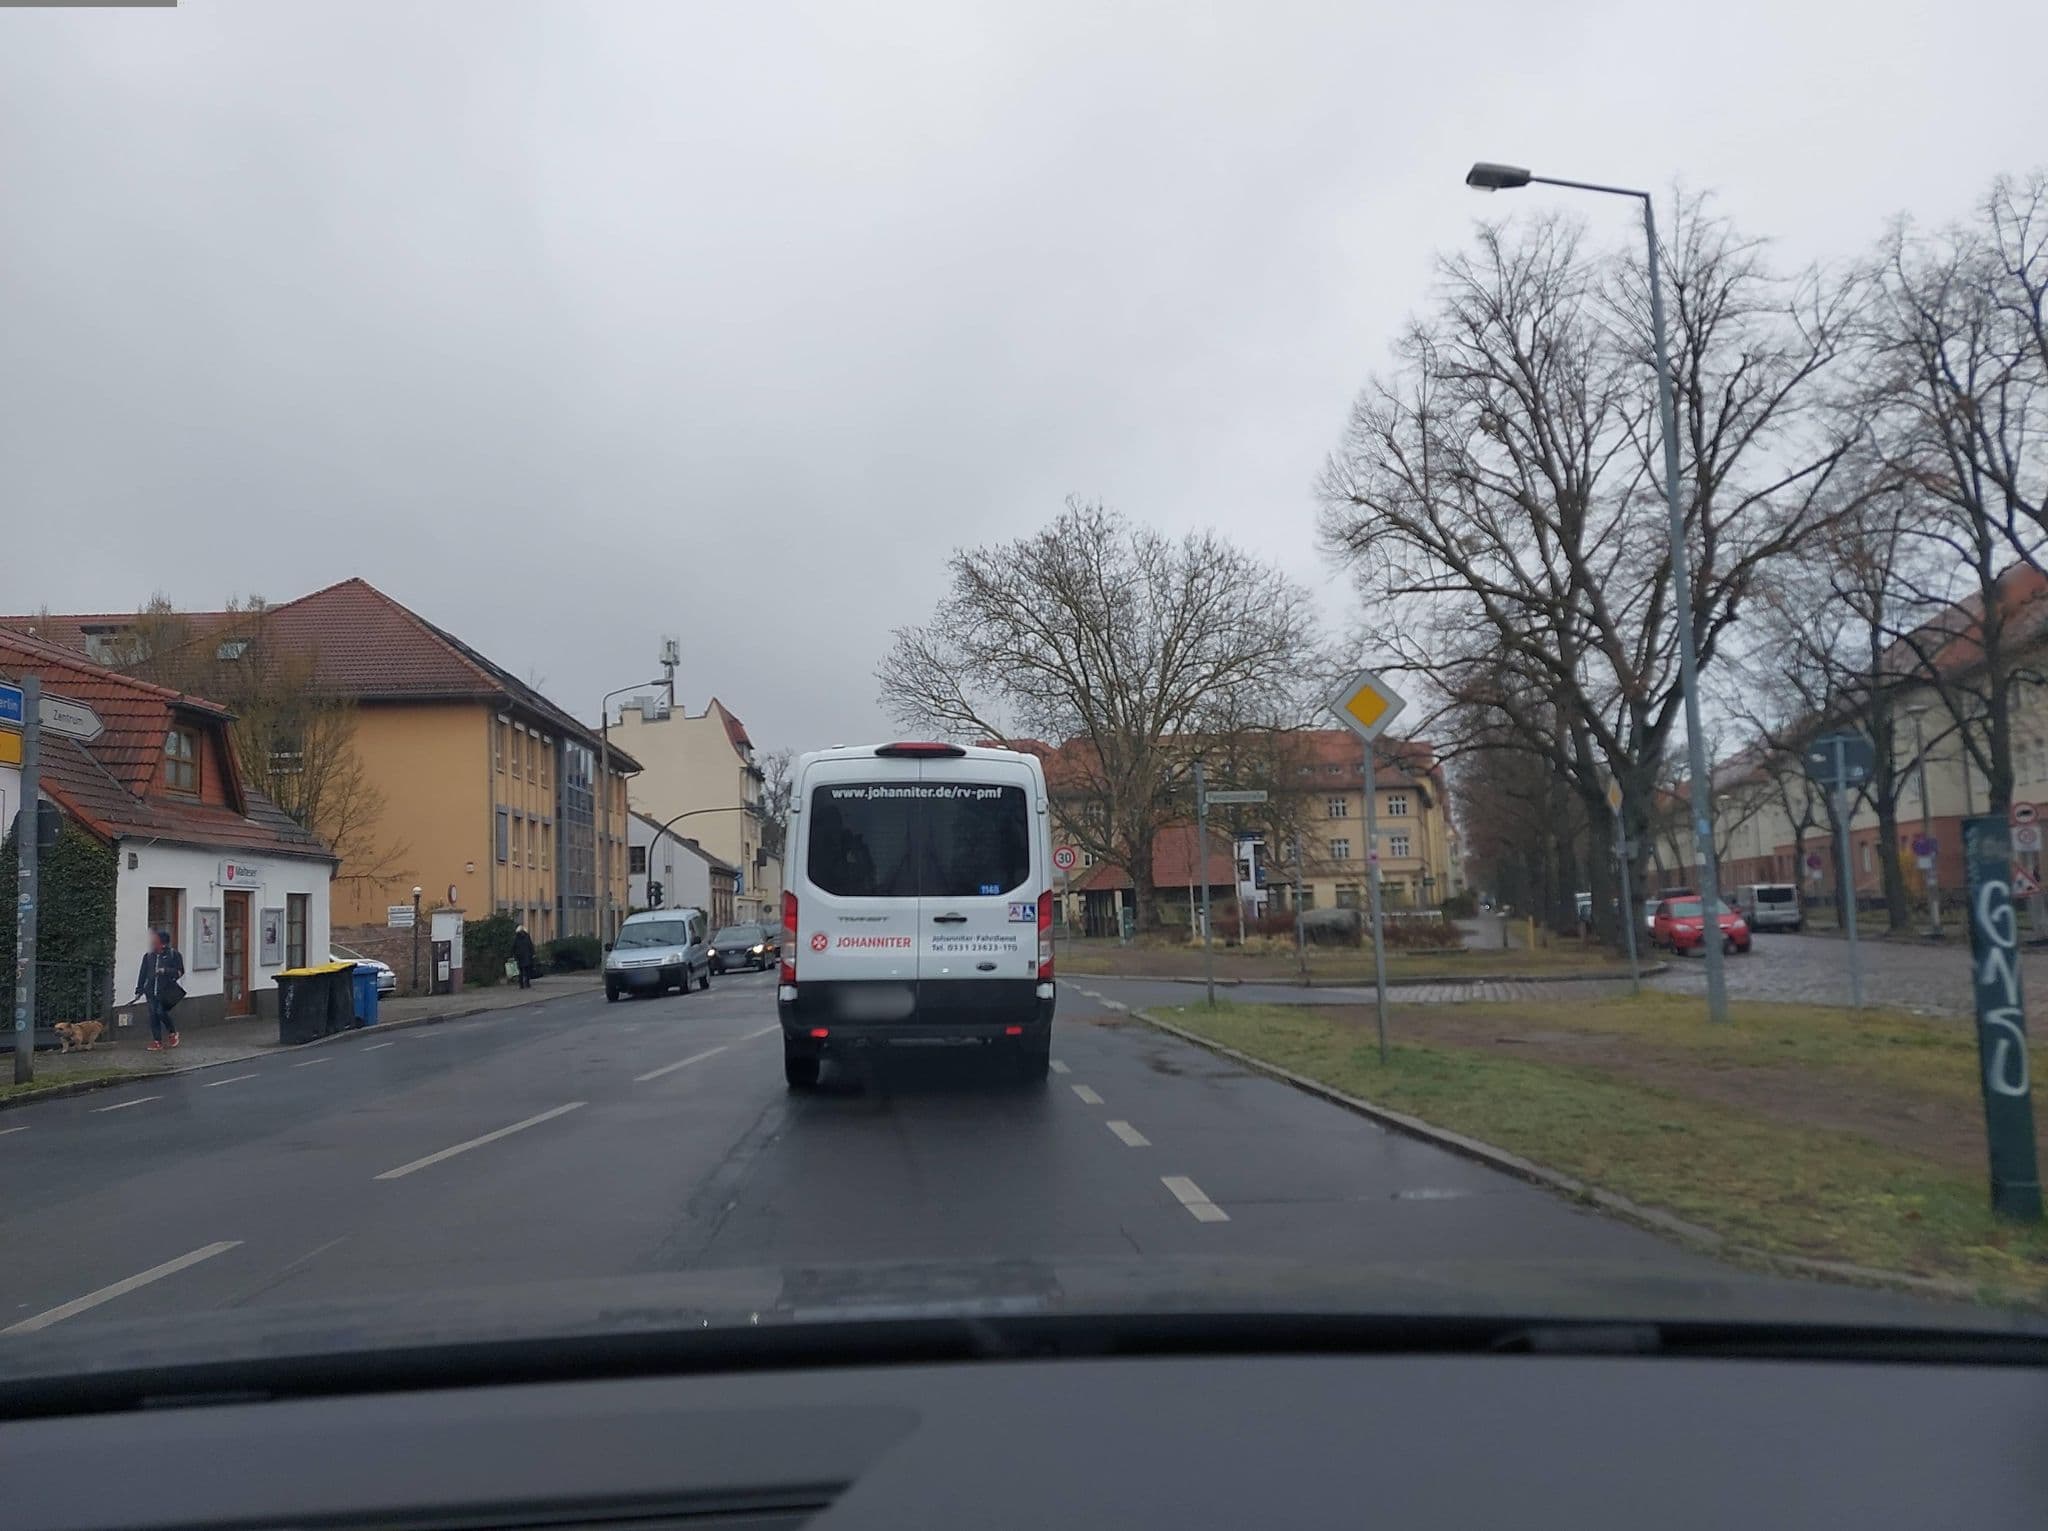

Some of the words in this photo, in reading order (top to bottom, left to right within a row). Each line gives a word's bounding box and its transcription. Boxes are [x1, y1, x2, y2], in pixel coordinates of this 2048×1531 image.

[53, 709, 84, 726] Zentrum
[831, 786, 1003, 800] www.johanniter.de/rv-pmf
[1058, 852, 1072, 864] 30
[836, 936, 912, 948] JOHANNITER
